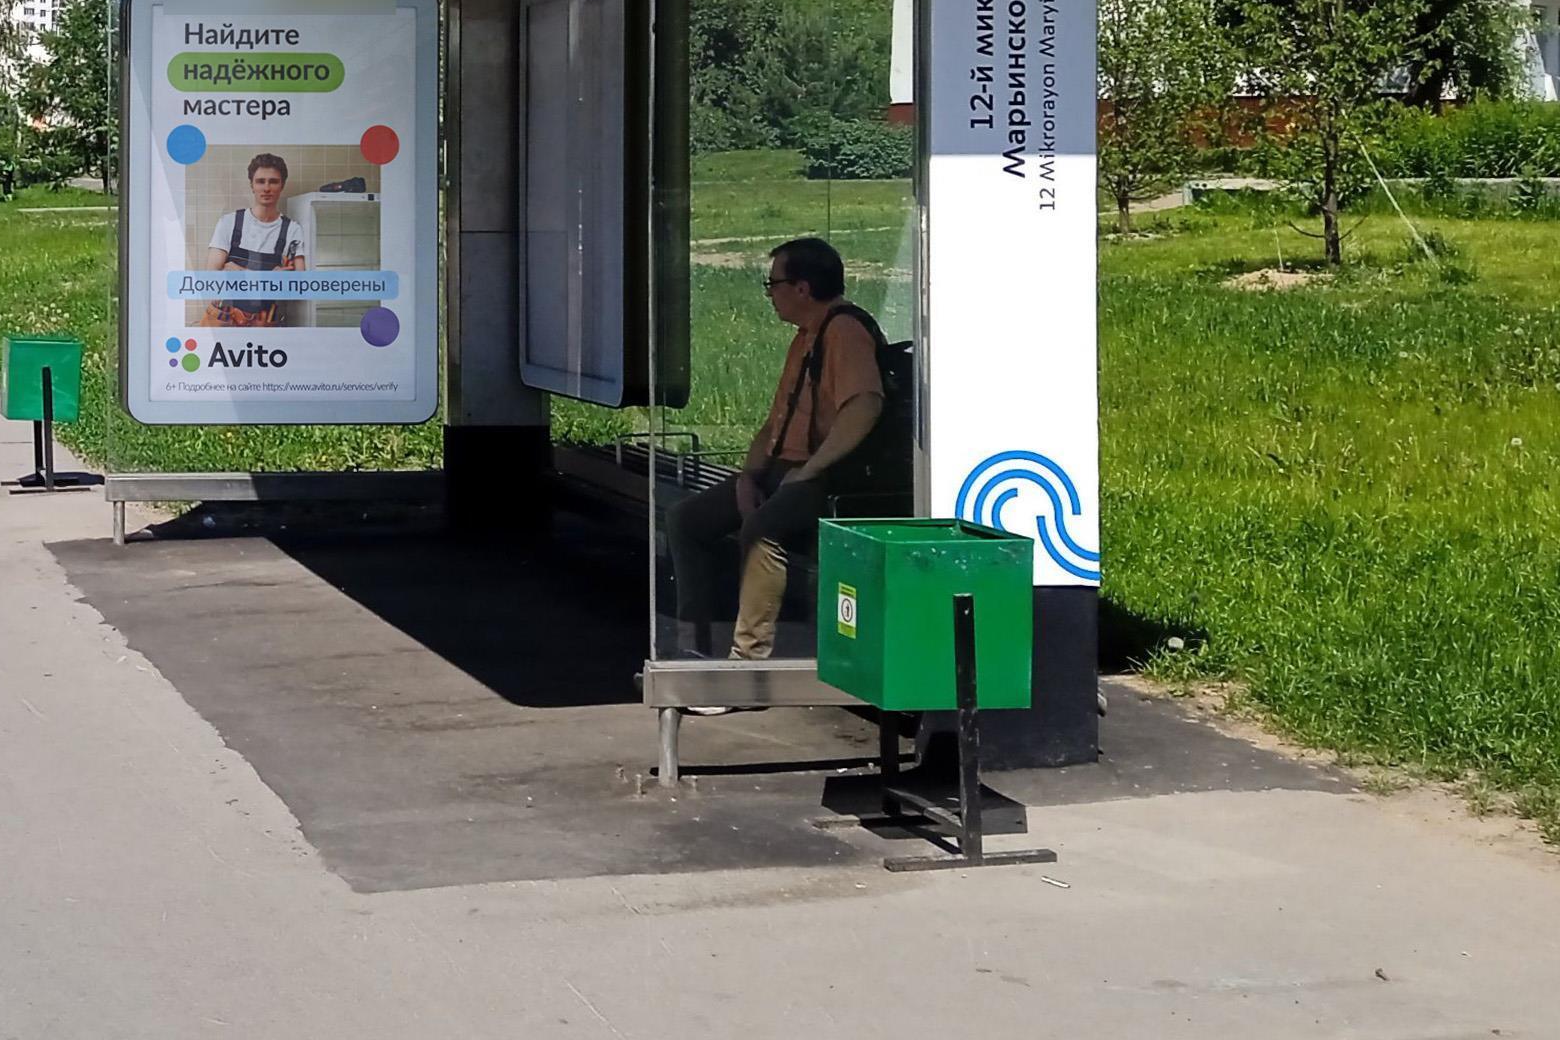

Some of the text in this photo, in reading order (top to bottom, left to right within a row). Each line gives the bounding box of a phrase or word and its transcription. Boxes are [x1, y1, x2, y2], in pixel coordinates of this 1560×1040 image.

[184, 22, 300, 49] Найдите
[183, 56, 330, 85] надёжного
[183, 98, 291, 120] мастера
[971, 66, 994, 129] 12-й
[1039, 63, 1059, 181] Mikrorayon
[1040, 187, 1056, 211] 12
[179, 276, 386, 296] Документы проверены
[208, 342, 288, 368] Avito
[179, 381, 225, 392] Подробнее
[238, 382, 261, 391] сайте
